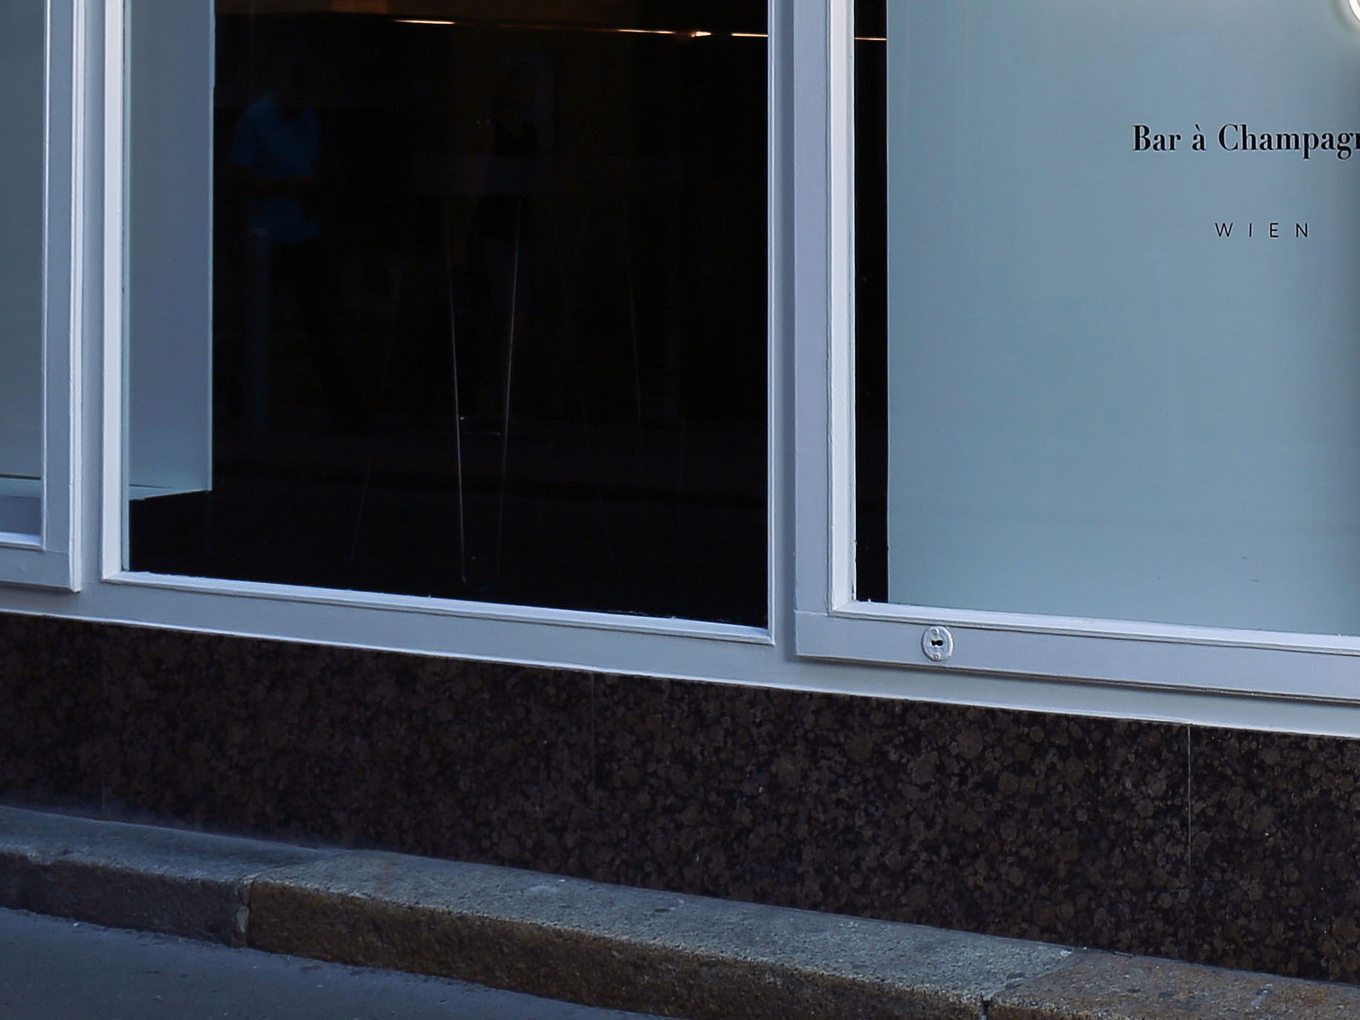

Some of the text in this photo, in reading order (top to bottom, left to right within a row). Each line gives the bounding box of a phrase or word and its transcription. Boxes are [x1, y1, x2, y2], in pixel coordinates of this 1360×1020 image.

[1132, 123, 1181, 151] Bar
[1192, 123, 1206, 151] à
[1214, 222, 1309, 238] WIEN
